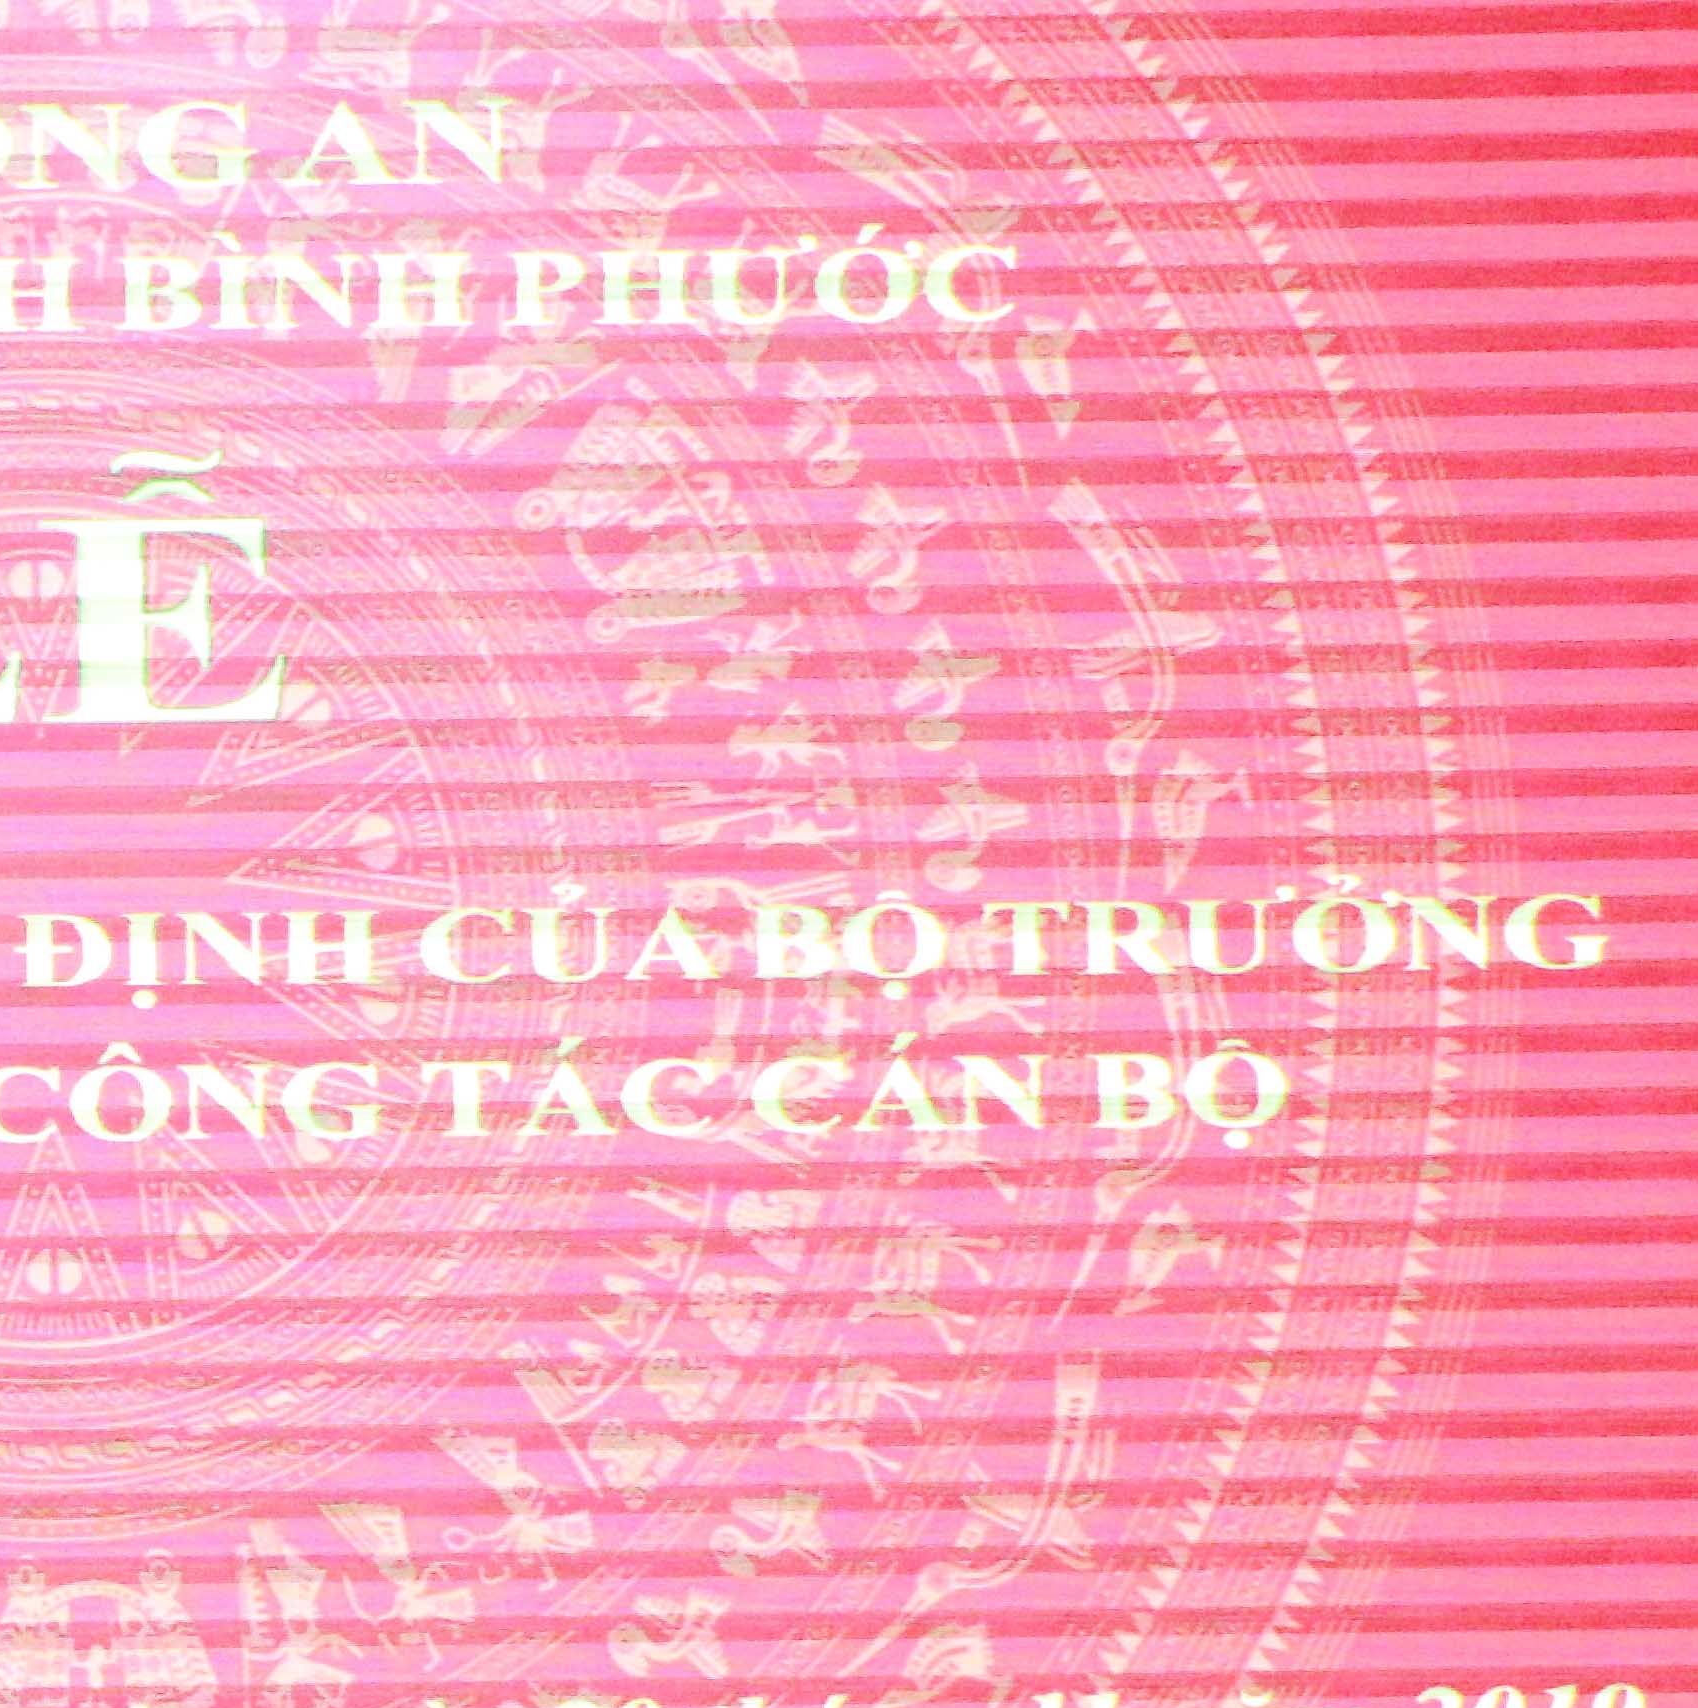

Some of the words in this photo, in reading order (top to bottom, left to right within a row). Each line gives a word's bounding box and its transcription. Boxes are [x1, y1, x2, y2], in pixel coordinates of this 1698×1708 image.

[283, 99, 514, 190] AN
[114, 230, 475, 333] BÌNH
[505, 222, 1017, 326] PHƯỚC
[13, 911, 382, 1009] ĐỊNH
[419, 884, 721, 984] CỦA
[752, 890, 947, 1001] BỘ
[982, 873, 1610, 977] TRƯỞNG
[421, 1037, 718, 1137] TÁC
[750, 1031, 1045, 1133] CÁN
[1091, 1039, 1288, 1149] BỘ
